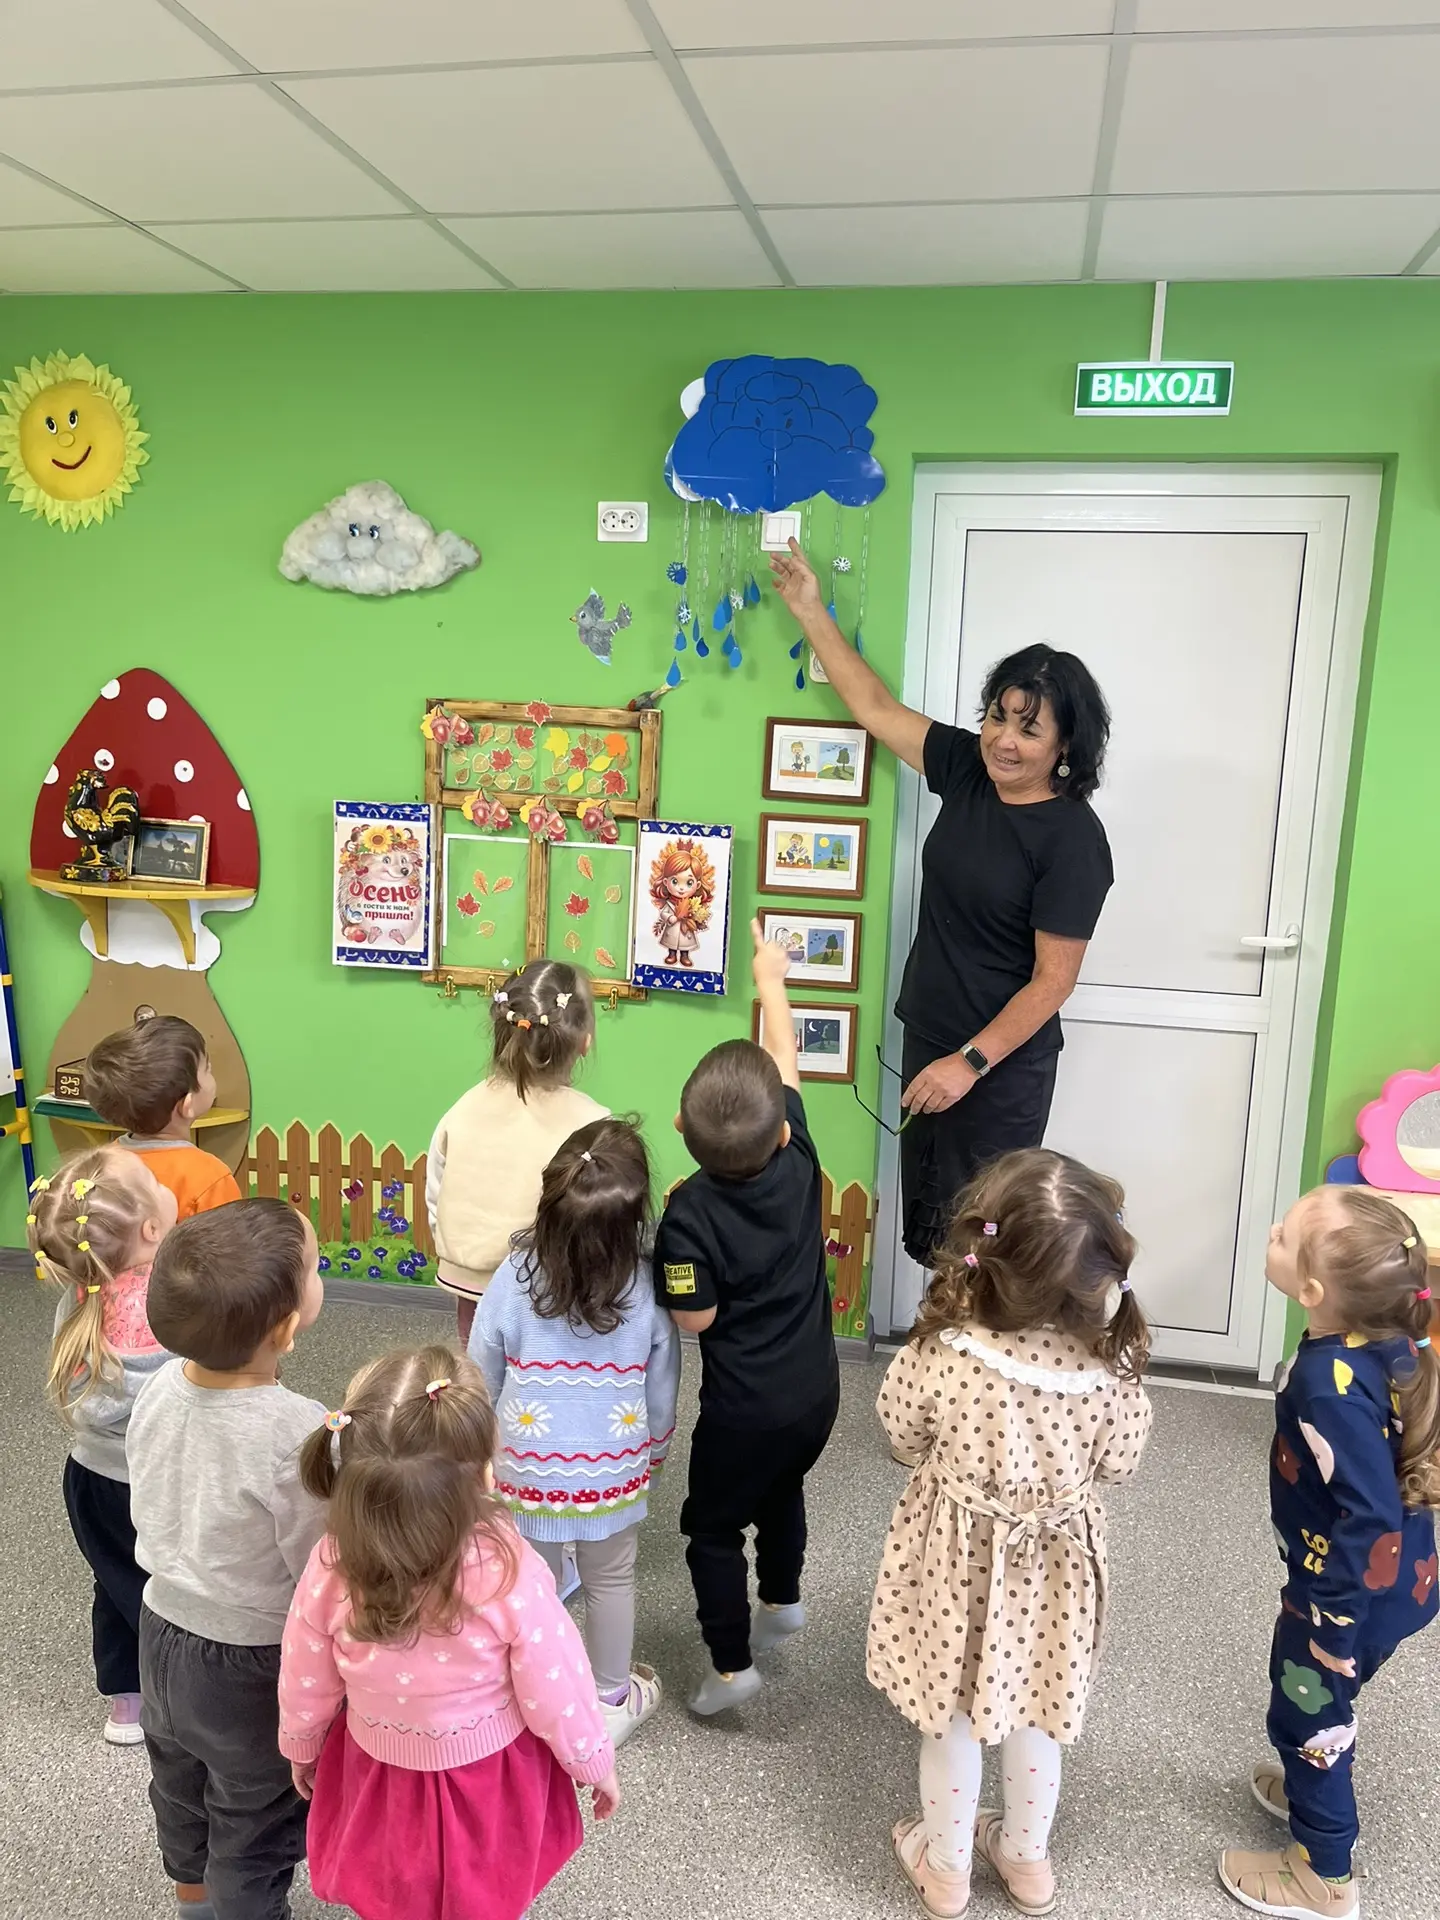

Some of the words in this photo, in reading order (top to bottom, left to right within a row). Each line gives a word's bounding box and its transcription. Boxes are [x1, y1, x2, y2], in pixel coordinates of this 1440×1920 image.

[1090, 371, 1217, 404] ВЫХОД
[349, 881, 420, 903] Осень
[364, 910, 414, 921] пришла!
